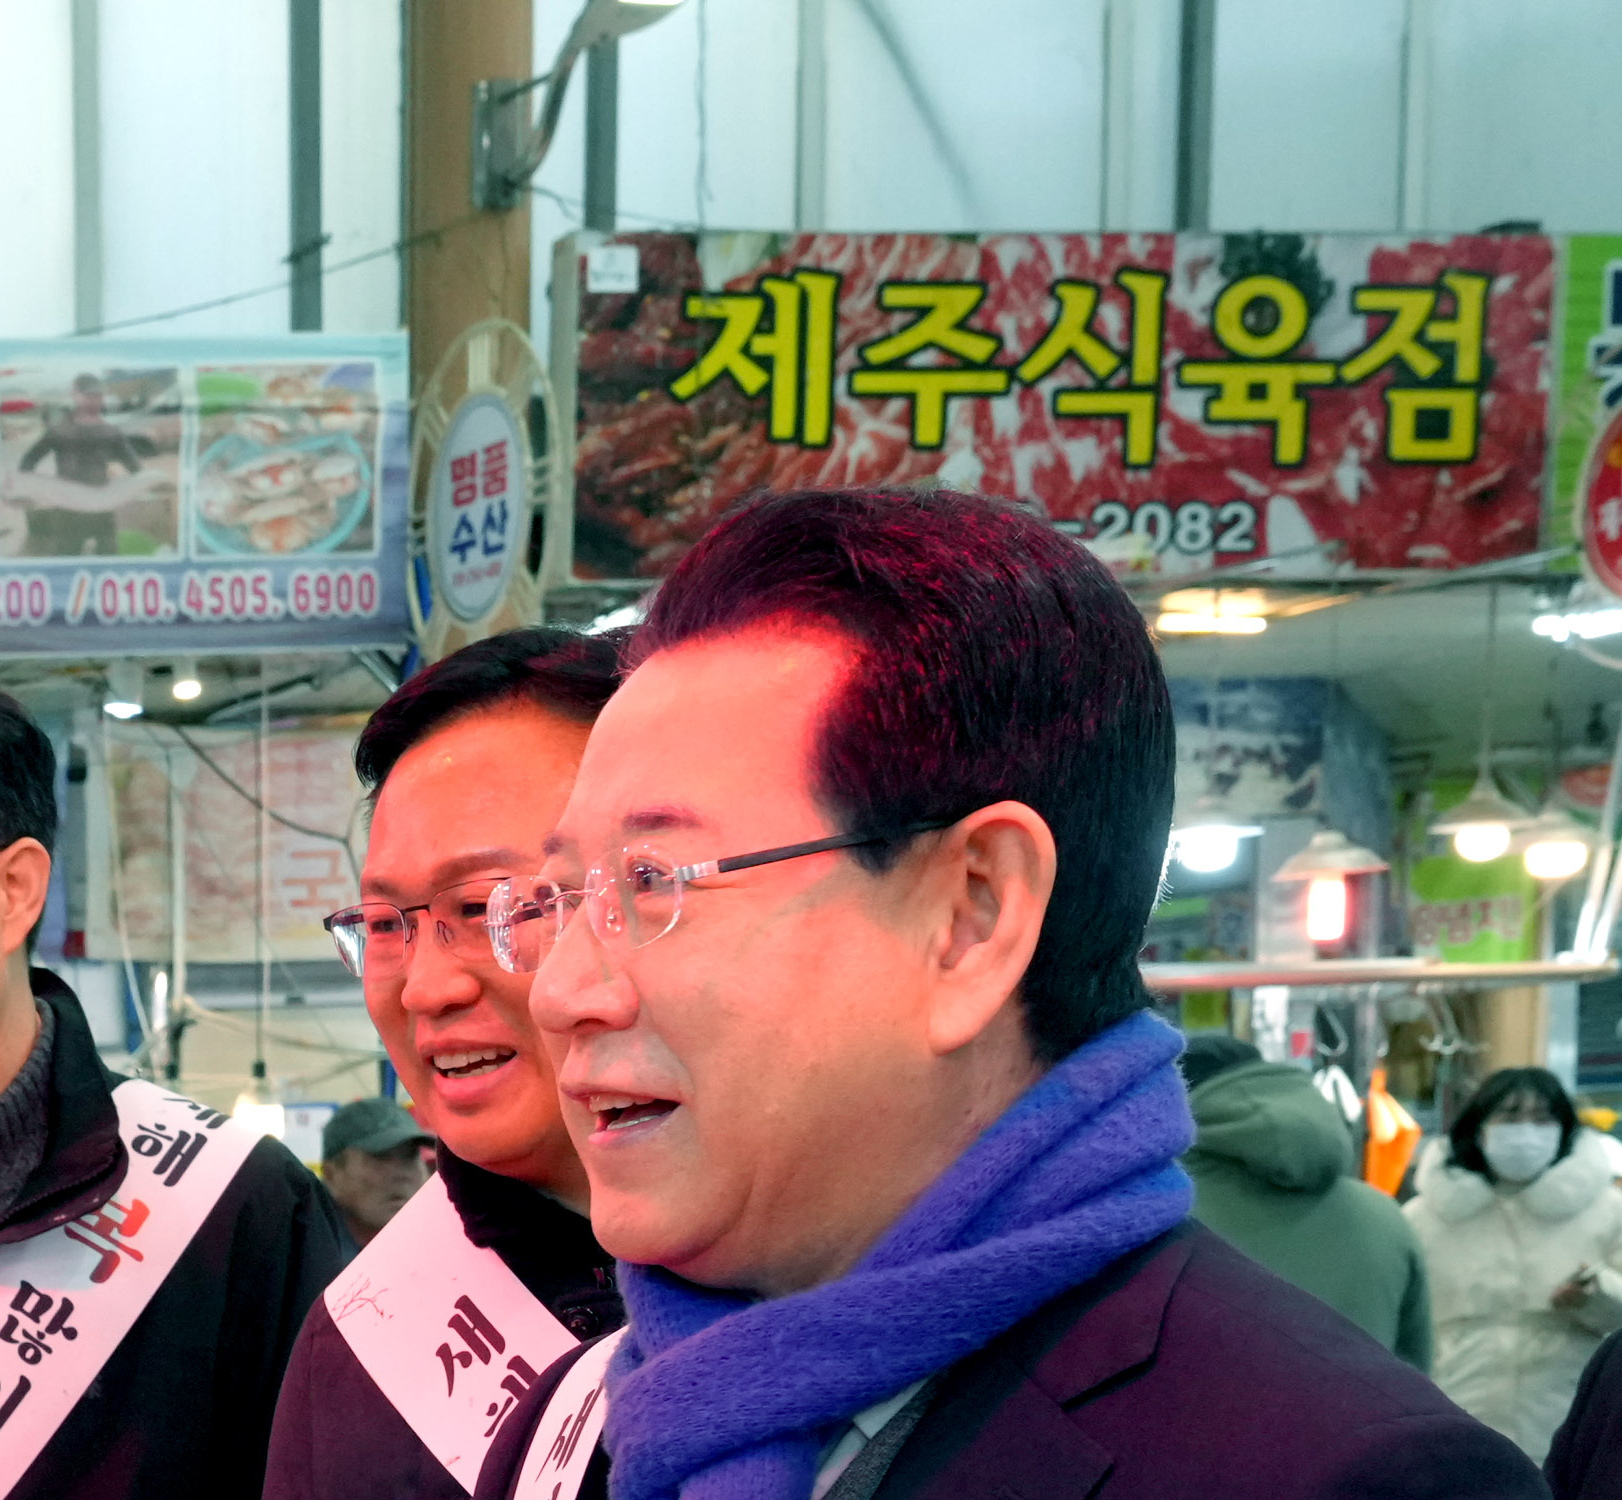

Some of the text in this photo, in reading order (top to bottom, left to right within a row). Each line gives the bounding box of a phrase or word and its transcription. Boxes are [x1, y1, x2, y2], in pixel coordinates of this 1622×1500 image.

[670, 268, 1490, 466] 제주식육점
[451, 439, 508, 507] 명품
[449, 499, 509, 565] 수산
